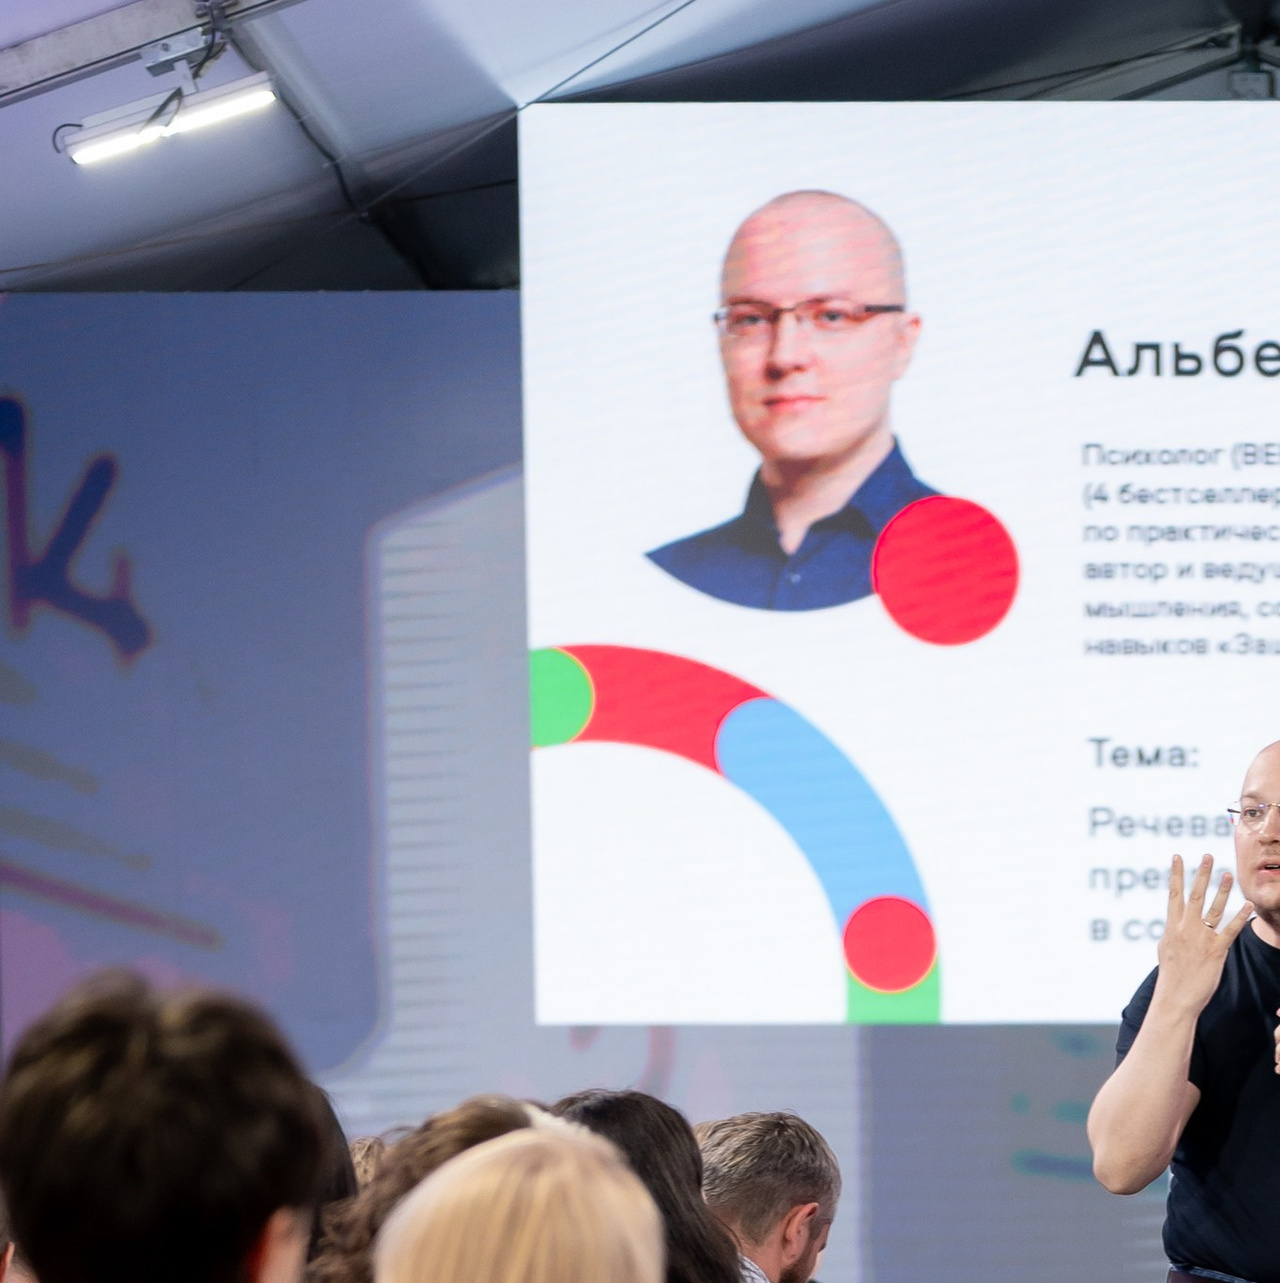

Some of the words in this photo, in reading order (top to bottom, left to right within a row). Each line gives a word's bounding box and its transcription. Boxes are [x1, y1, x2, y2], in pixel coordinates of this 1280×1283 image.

[1082, 443, 1226, 467] Психолог
[1083, 482, 1111, 509] (4
[1083, 523, 1119, 542] по
[1083, 562, 1169, 584] автор
[1176, 562, 1194, 579] и
[1084, 599, 1249, 620] мышления,
[1084, 637, 1209, 656] навыков
[1087, 737, 1199, 768] Тема:
